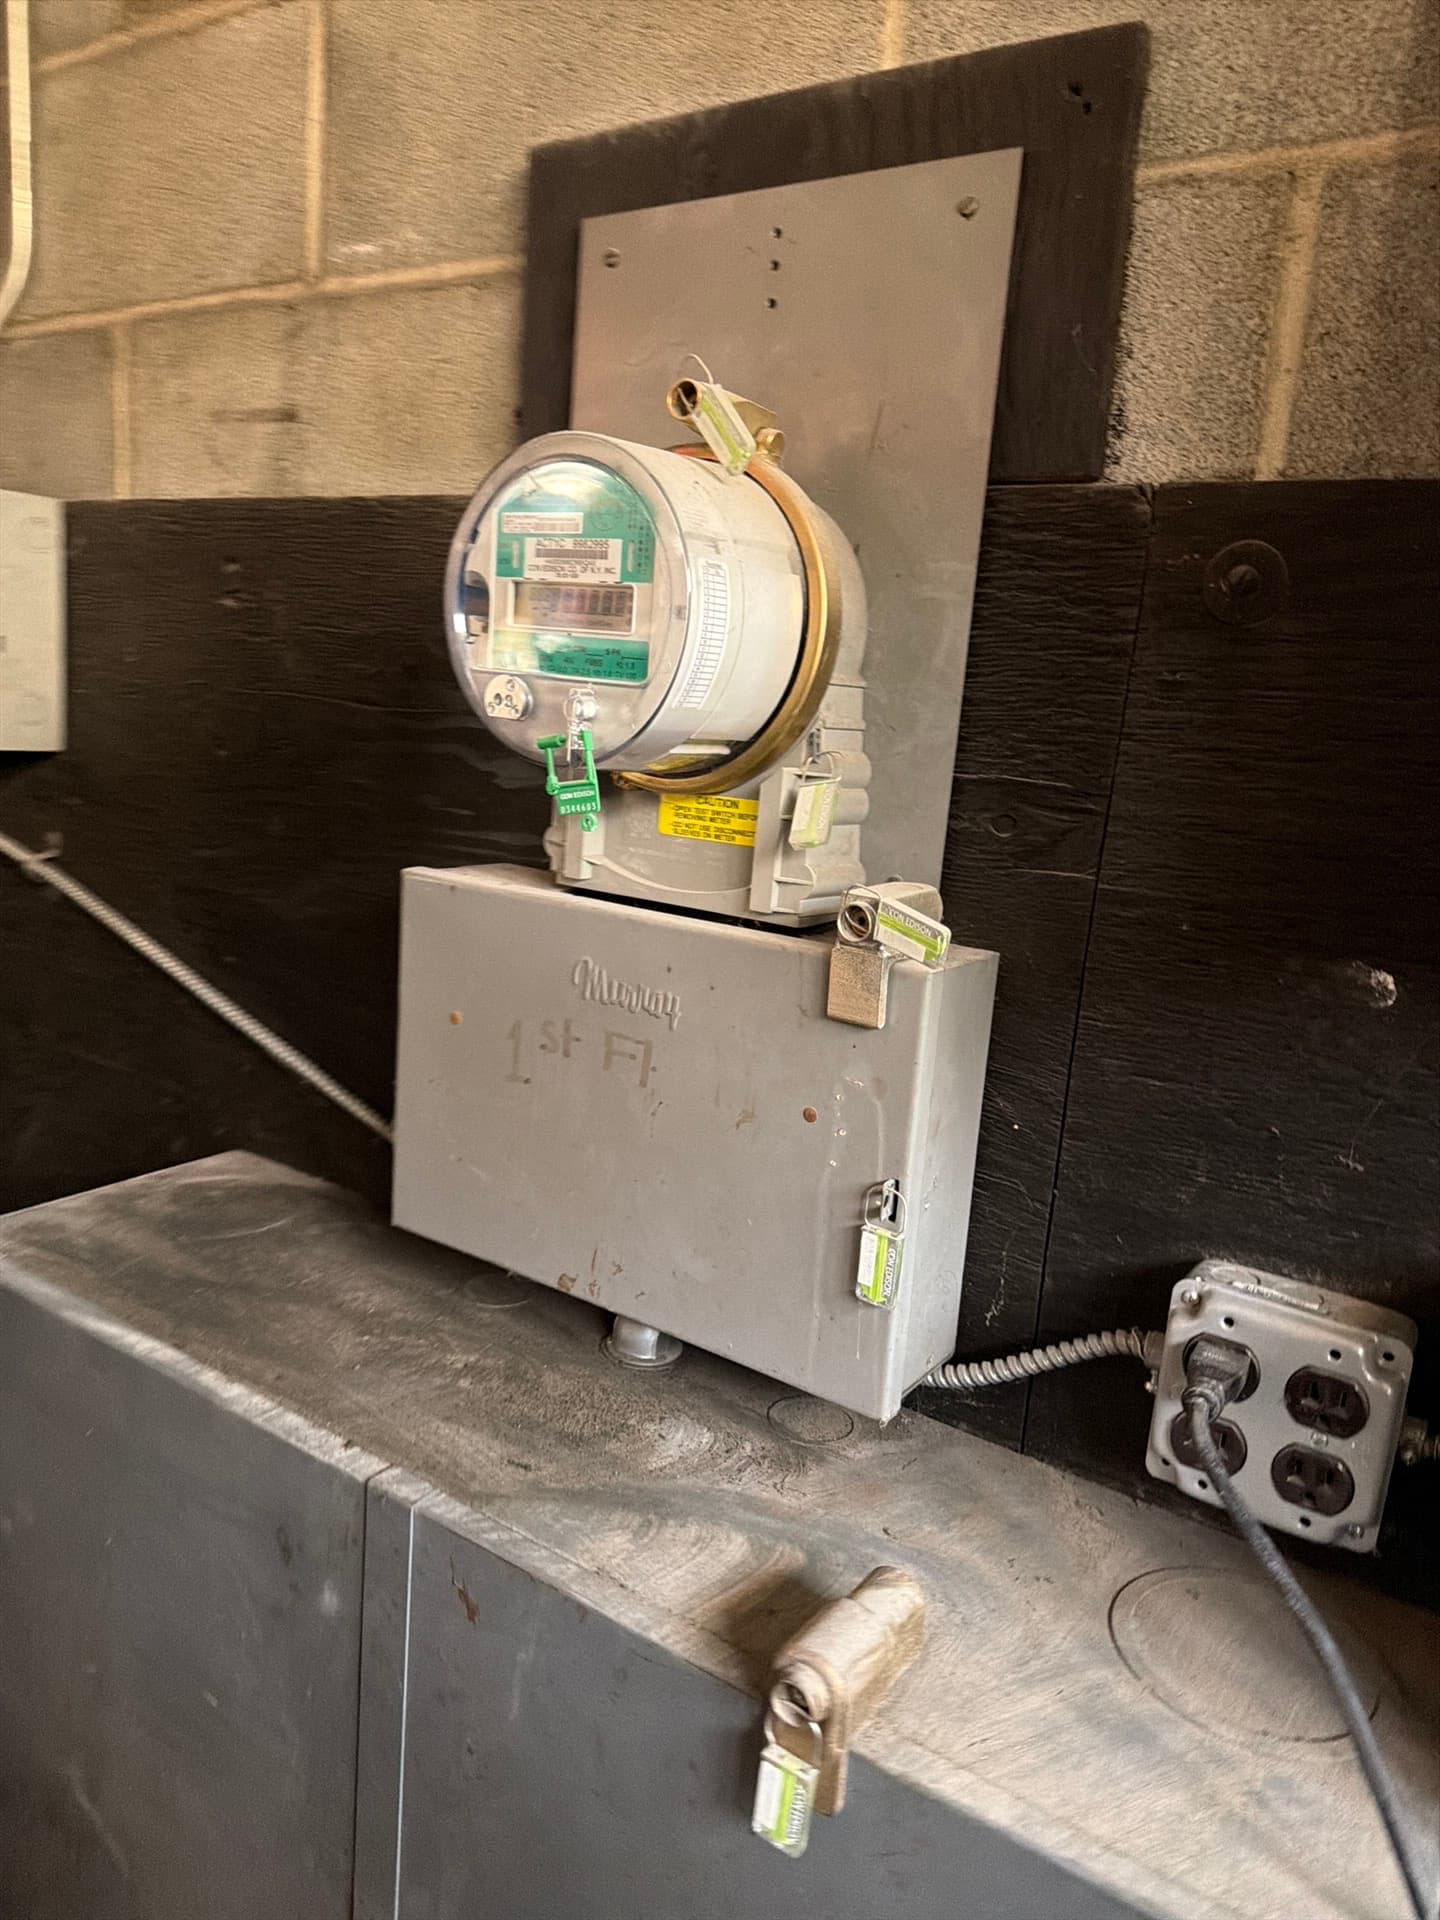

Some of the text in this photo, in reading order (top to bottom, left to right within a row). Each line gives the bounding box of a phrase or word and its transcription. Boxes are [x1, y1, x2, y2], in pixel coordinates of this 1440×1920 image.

[695, 796, 740, 809] CAUTION
[906, 916, 932, 937] EDISON
[572, 956, 682, 1031] Murray
